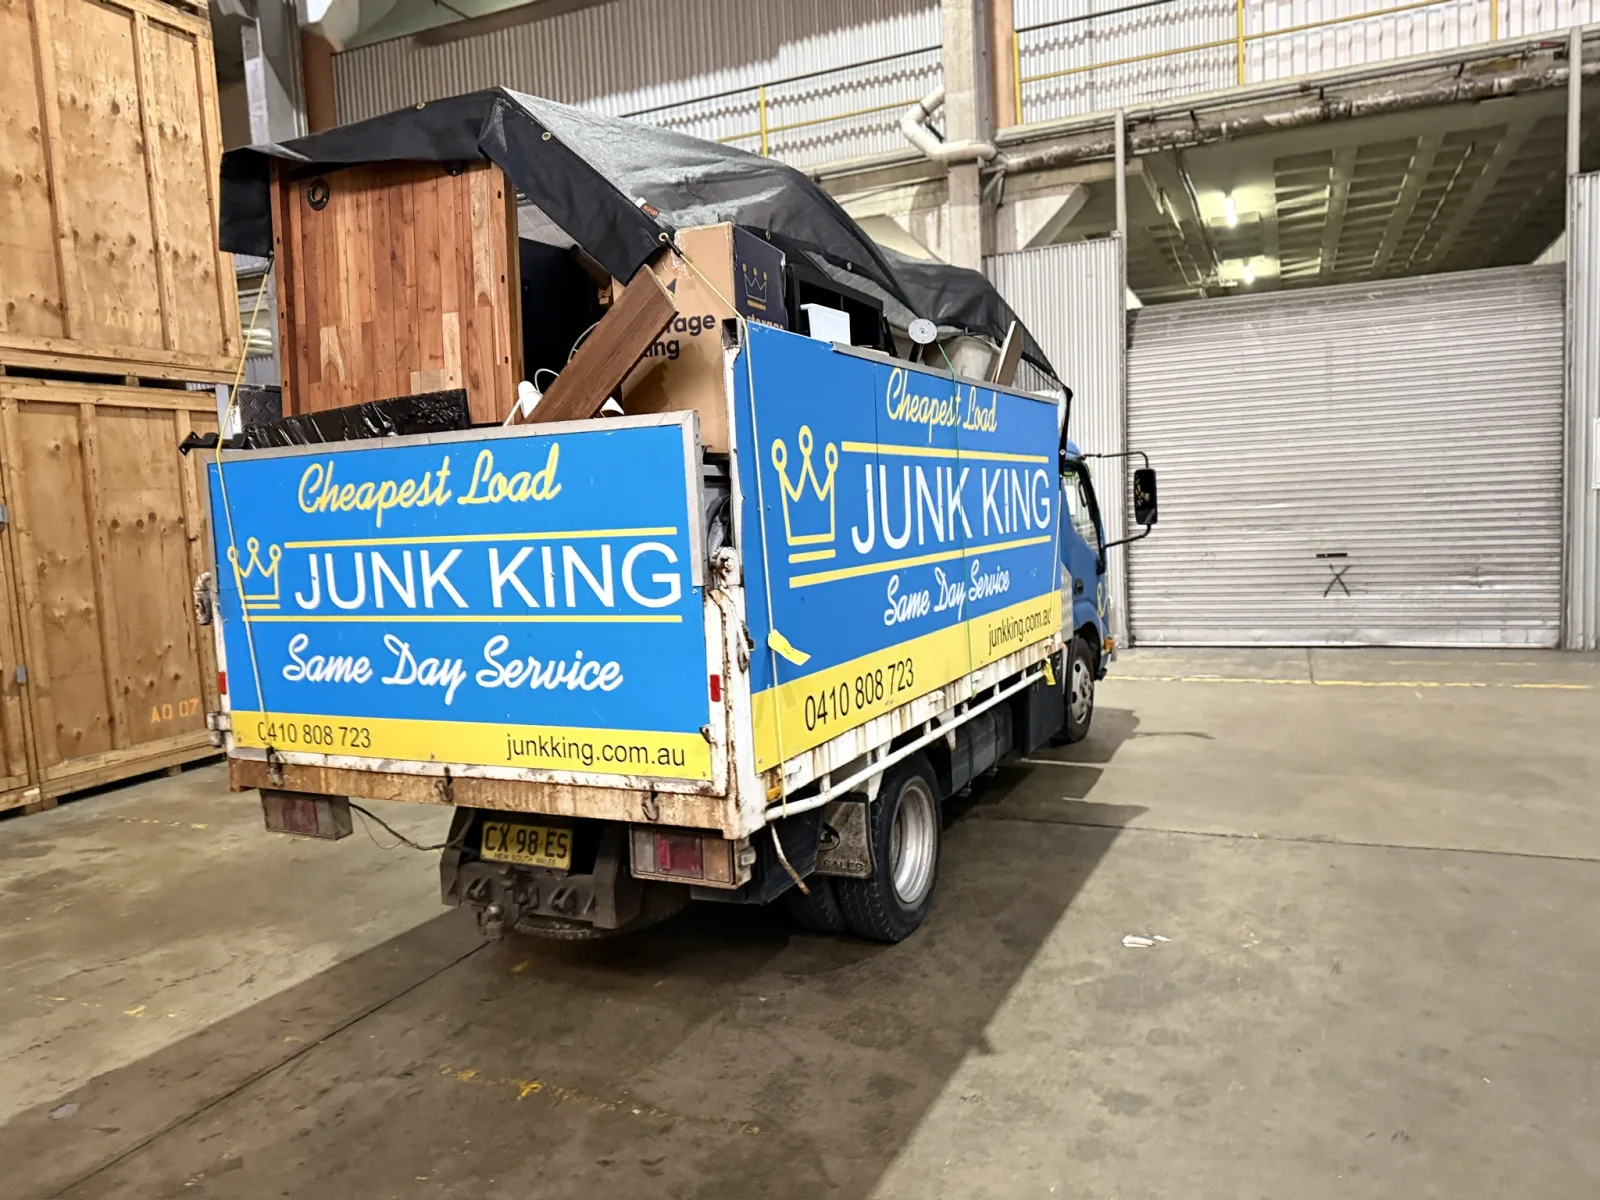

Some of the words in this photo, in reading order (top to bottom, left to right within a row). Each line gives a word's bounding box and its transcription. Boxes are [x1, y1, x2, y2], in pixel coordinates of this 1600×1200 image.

[644, 339, 680, 360] ing
[885, 367, 961, 444] Cheapest
[963, 385, 998, 433] Load
[298, 456, 451, 528] Cheapest
[457, 442, 562, 505] Load
[851, 463, 973, 554] JUNK
[981, 468, 1051, 538] KING
[294, 548, 469, 610] JUNK
[488, 541, 682, 608] KING
[884, 574, 930, 626] Same
[934, 566, 967, 621] Day
[968, 558, 1011, 602] Service
[282, 633, 373, 685] Same
[381, 633, 467, 706] Day
[475, 634, 624, 692] Service
[804, 682, 850, 732] 0410
[855, 667, 884, 711] 808
[887, 657, 915, 692] 723
[257, 722, 297, 743] 0410
[302, 725, 333, 746] 808
[338, 726, 371, 749] 723
[506, 732, 685, 767] junkking.com.au
[484, 825, 511, 853] CX
[516, 829, 539, 856] 98
[544, 831, 569, 859] ES
